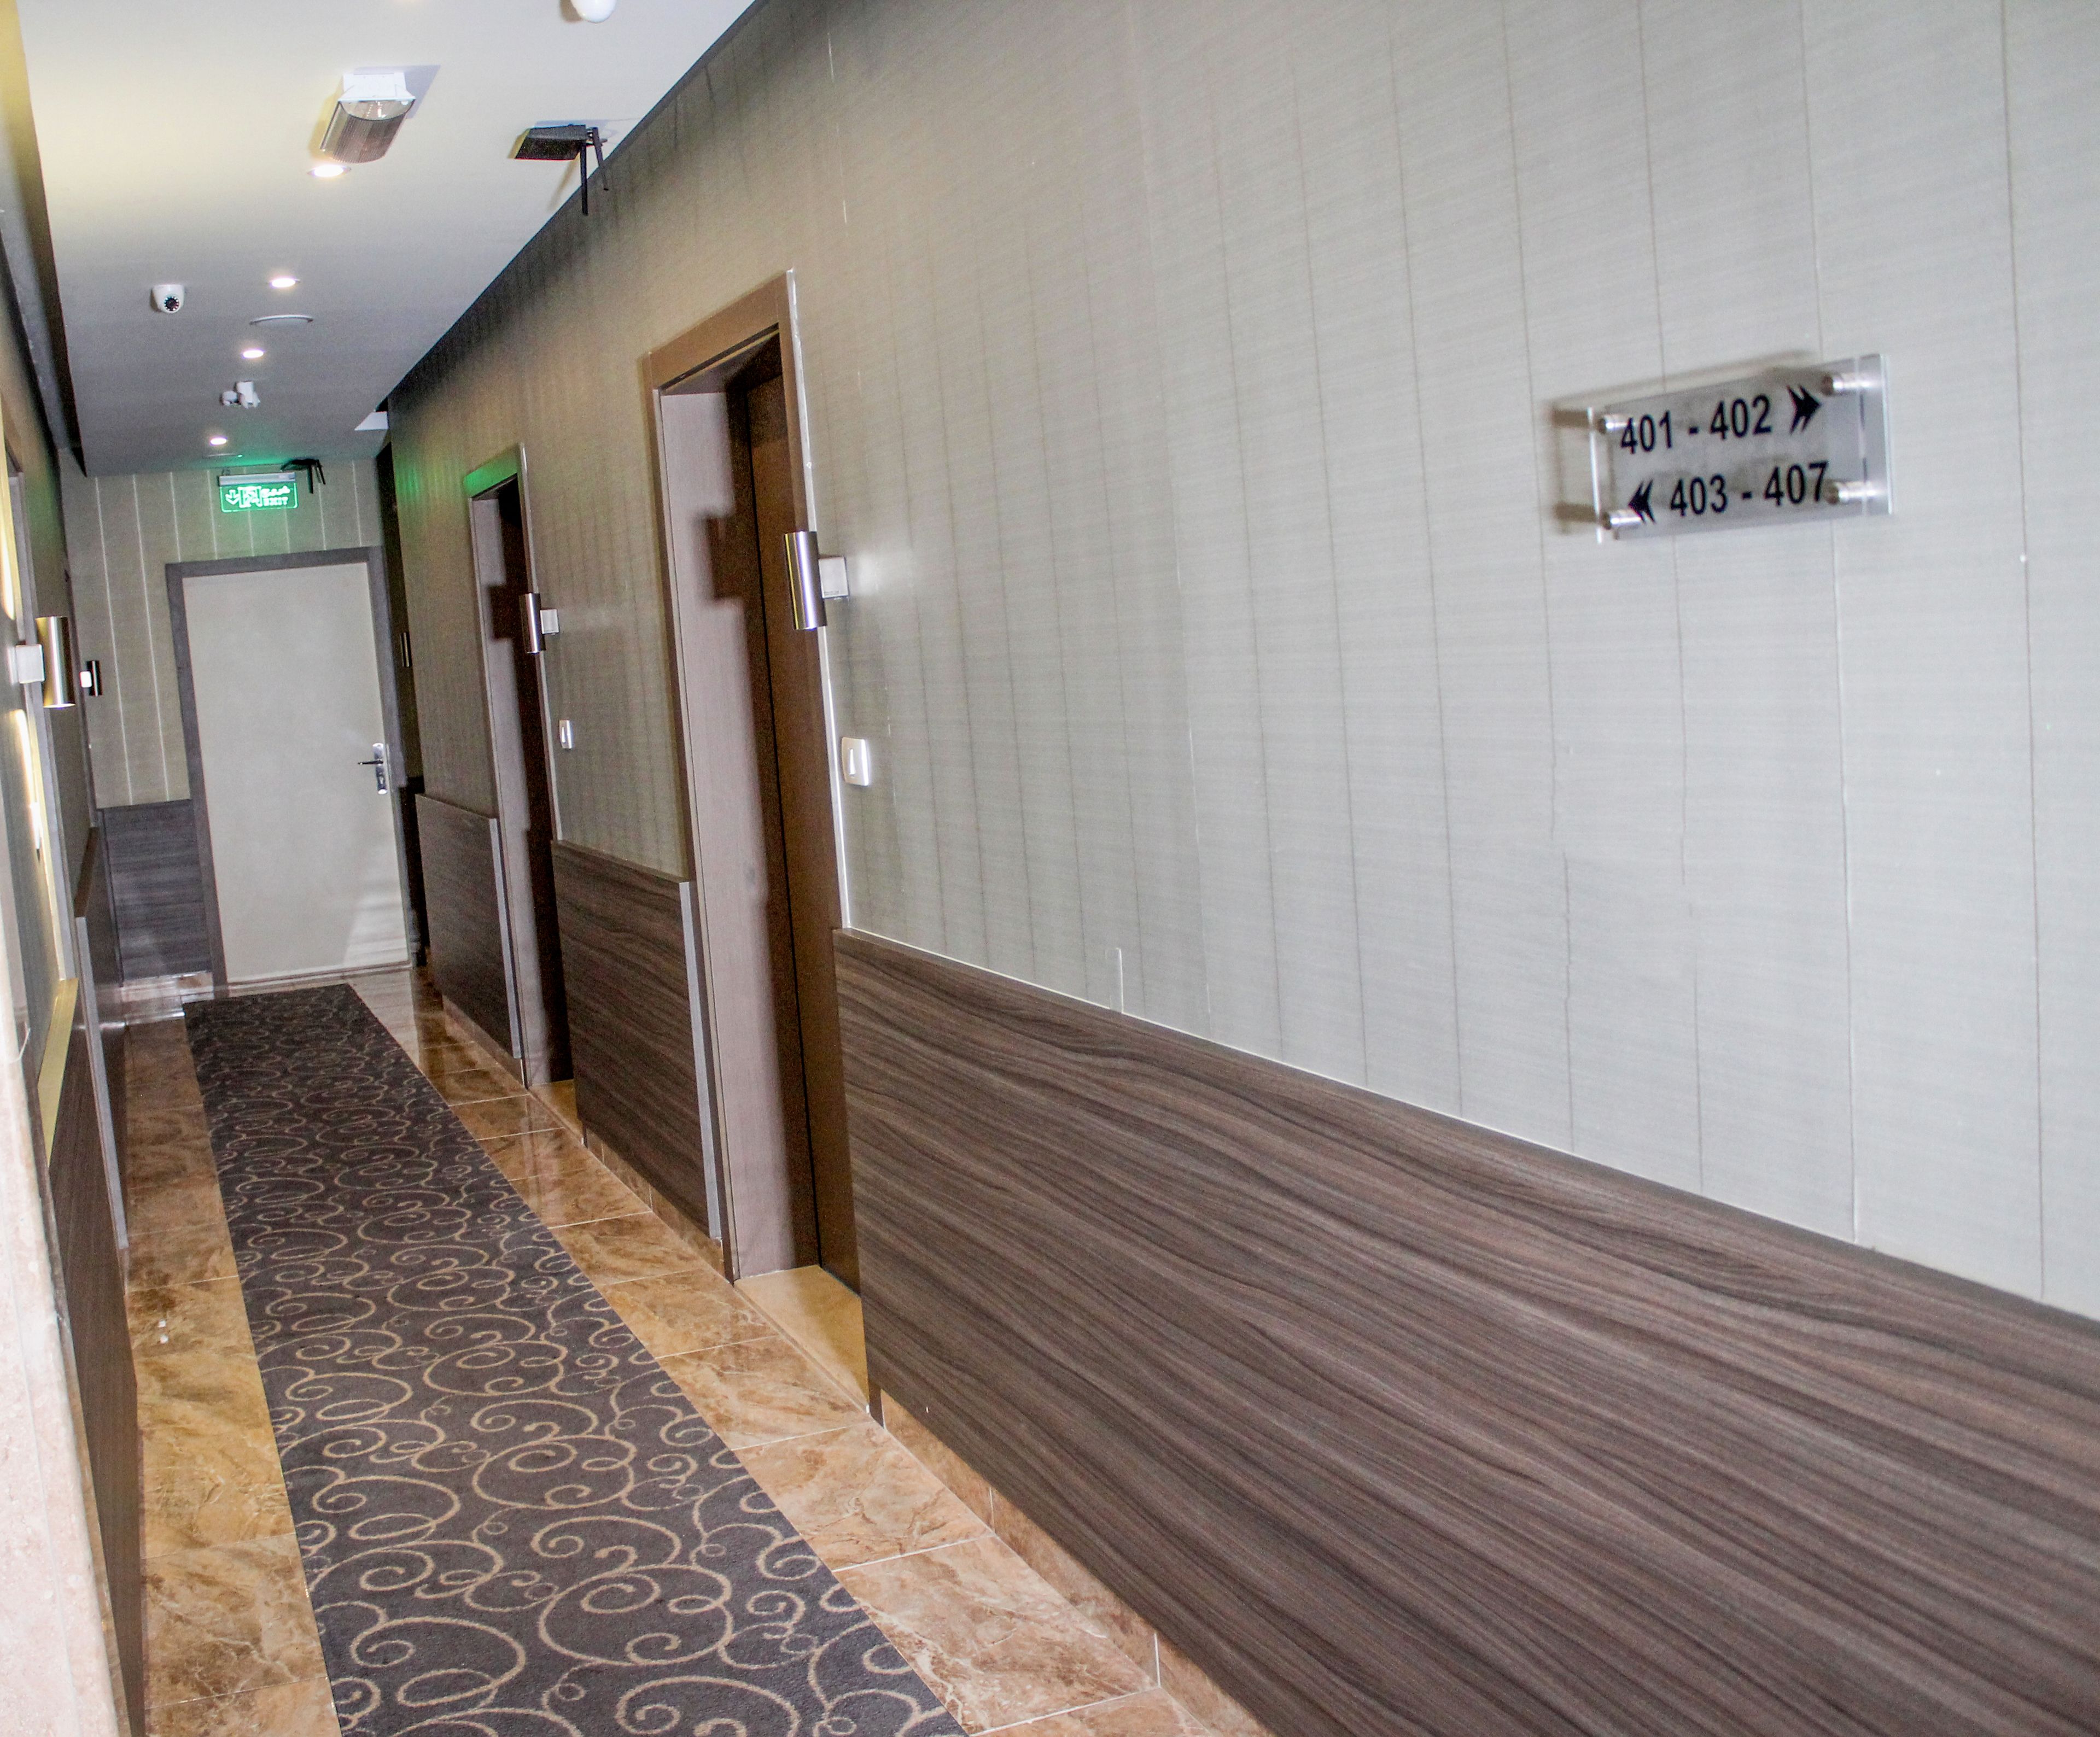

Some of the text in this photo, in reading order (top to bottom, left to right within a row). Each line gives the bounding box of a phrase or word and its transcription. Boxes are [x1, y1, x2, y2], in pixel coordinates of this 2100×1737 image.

[1620, 410, 1673, 454] 401
[1709, 394, 1772, 440] 402
[263, 496, 288, 506] EXIT
[1670, 473, 1729, 517] 403
[1764, 460, 1829, 507] 407
